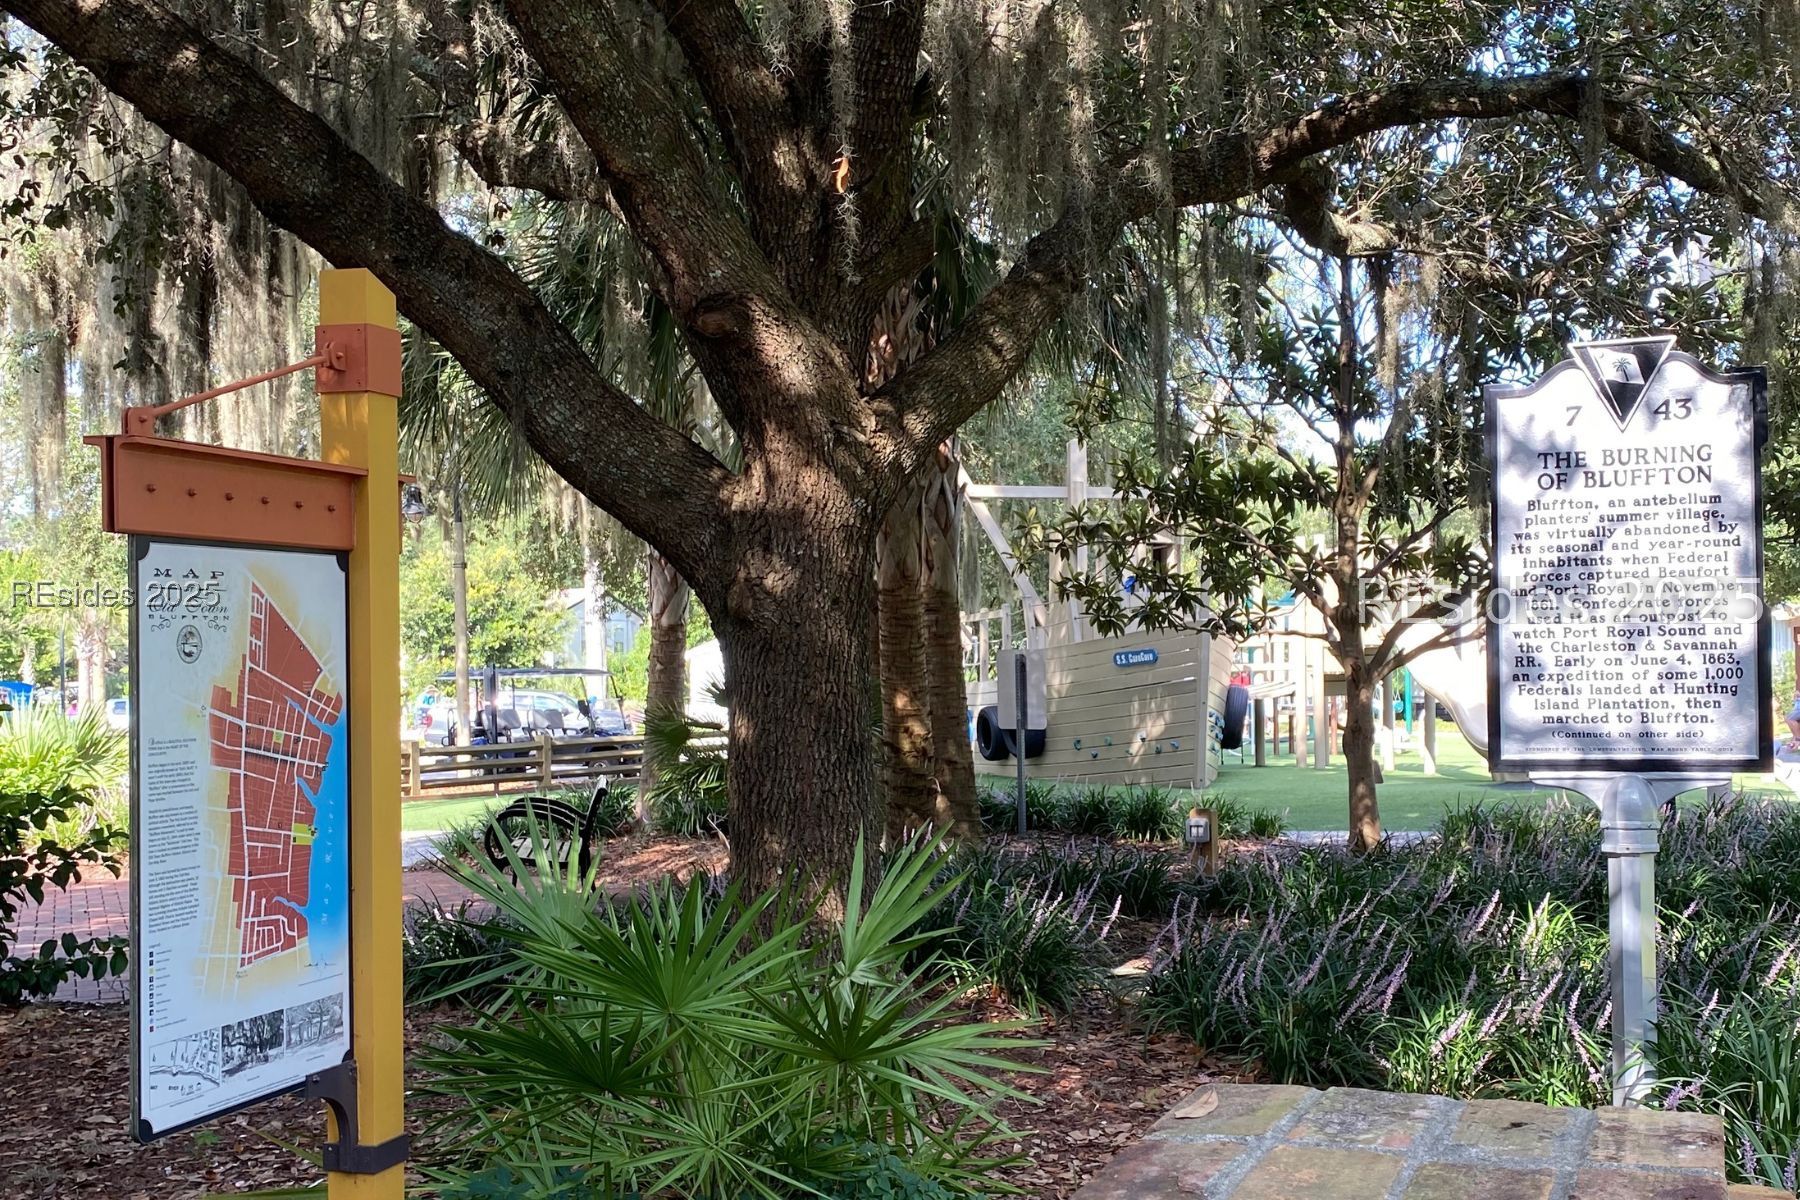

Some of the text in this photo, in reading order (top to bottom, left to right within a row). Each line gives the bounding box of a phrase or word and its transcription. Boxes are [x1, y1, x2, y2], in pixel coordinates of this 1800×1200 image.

[1566, 406, 1582, 426] 7
[1653, 398, 1692, 420] 43
[1537, 444, 1712, 469] THE BURNING
[1538, 465, 1712, 490] OF BLUFFTON
[1527, 494, 1722, 512] Bluffton, an antebellum
[1525, 508, 1725, 529] planters' summer village,
[1514, 520, 1738, 541] was virtually abandoned by
[1511, 536, 1741, 555] its seasonal and year-round
[1523, 552, 1728, 568] inhabitants when Federal
[153, 568, 224, 580] MAP
[1523, 566, 1729, 582] forces captured Beaufort
[1511, 585, 1536, 597] and
[1545, 585, 1578, 596] Port
[1587, 582, 1631, 595] Royal
[1662, 580, 1742, 593] November
[1572, 596, 1670, 610] Confederate
[1677, 595, 1728, 606] forces
[1527, 610, 1727, 625] used it as an outpost to
[1512, 623, 1742, 640] watch Port Royal Sound and
[1518, 638, 1737, 654] the Charleston & Savannah
[1515, 651, 1741, 668] RR. Early on June 4, 1863,
[1512, 667, 1744, 684] an expedition of some 1,000
[1518, 681, 1738, 696] Federals landed at Hunting
[1534, 696, 1722, 711] Island Plantation, then
[1542, 710, 1715, 724] marched to Bluffton.
[1552, 729, 1612, 740] (Continued
[1638, 729, 1668, 739] other
[1676, 728, 1704, 739] side)
